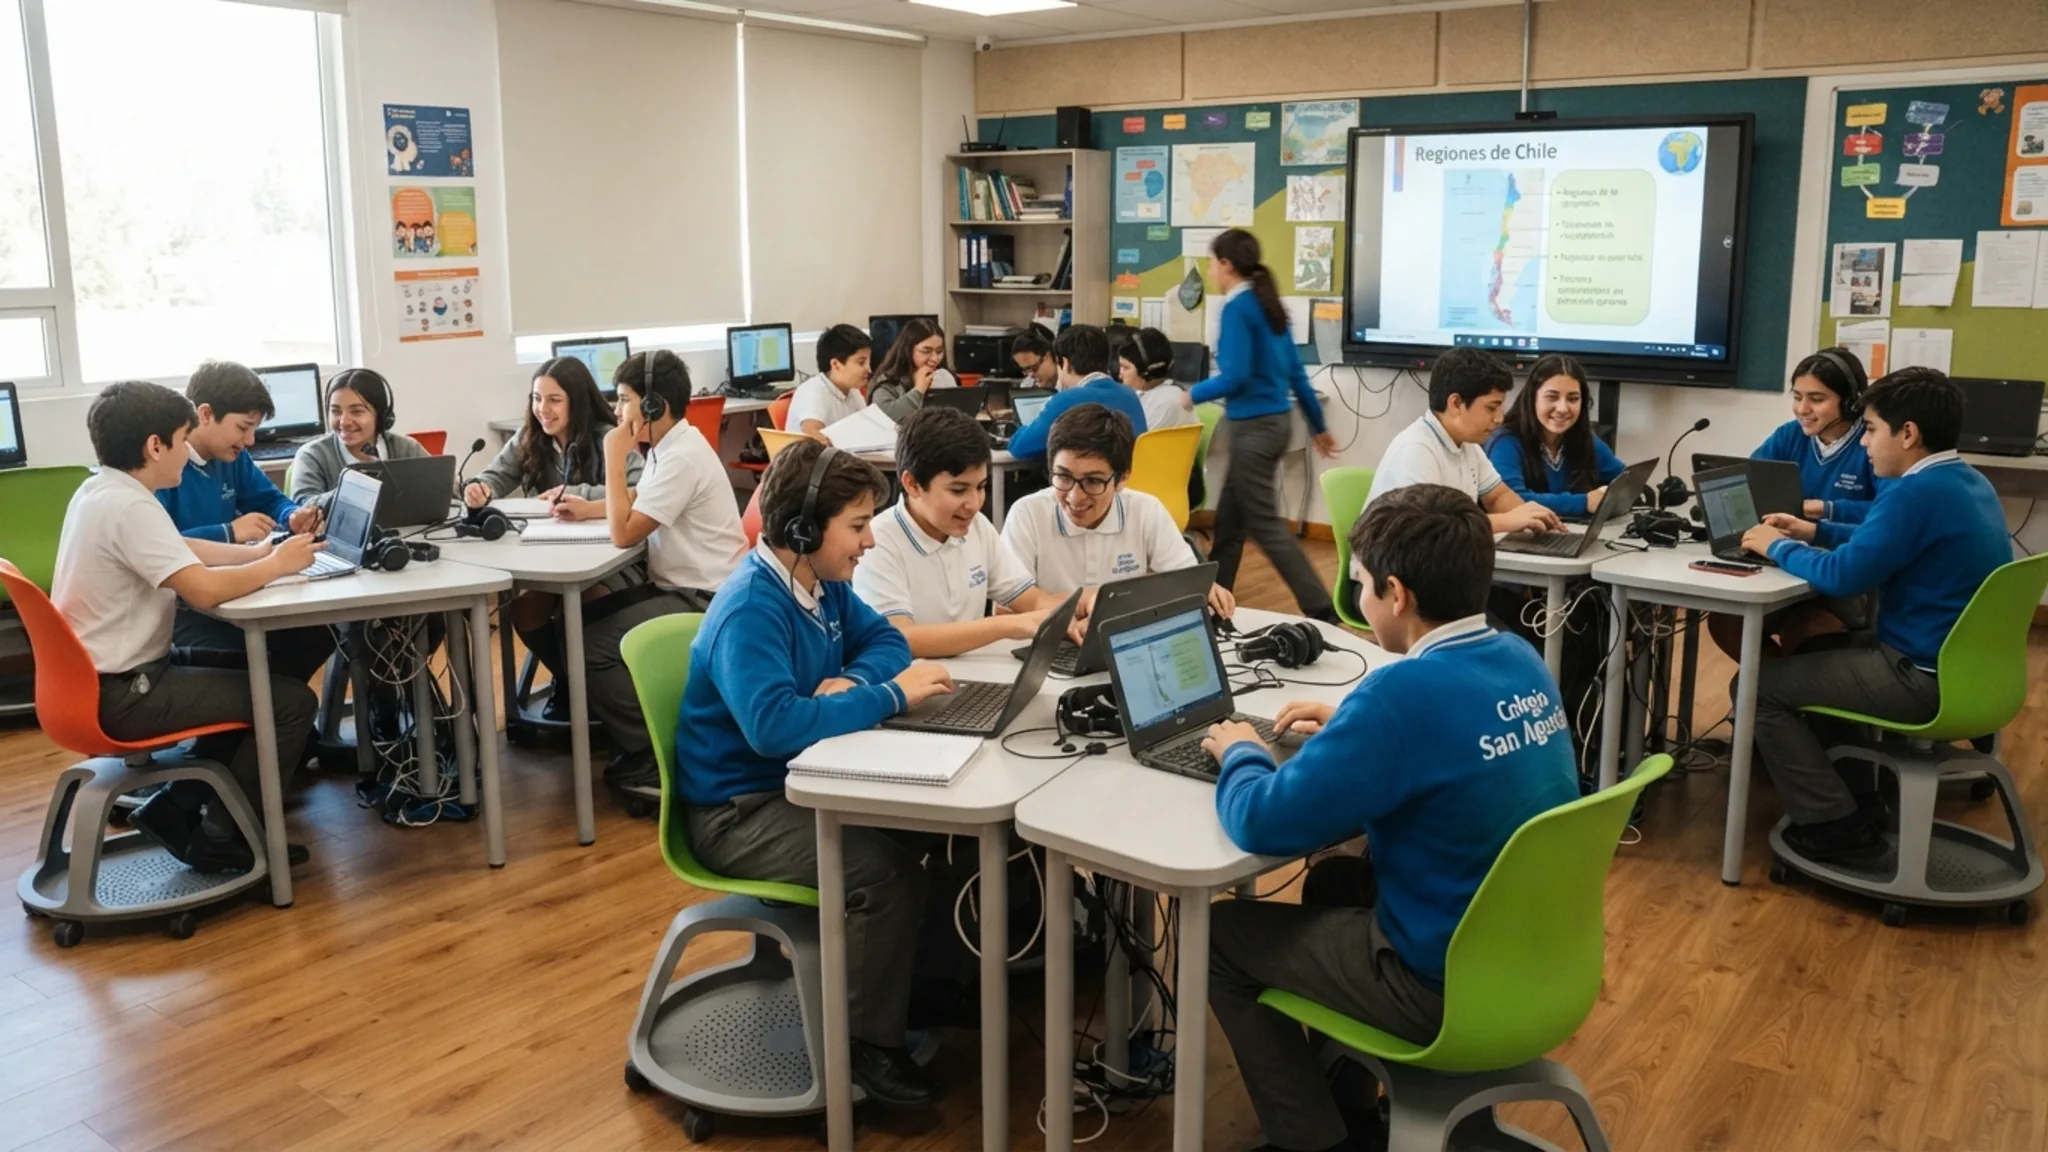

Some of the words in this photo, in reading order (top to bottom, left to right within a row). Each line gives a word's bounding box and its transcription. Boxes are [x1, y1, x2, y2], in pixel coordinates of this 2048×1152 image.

[1415, 145, 1487, 164] Regiones
[1490, 143, 1511, 160] de
[1515, 142, 1558, 160] Chile
[1479, 732, 1521, 760] San
